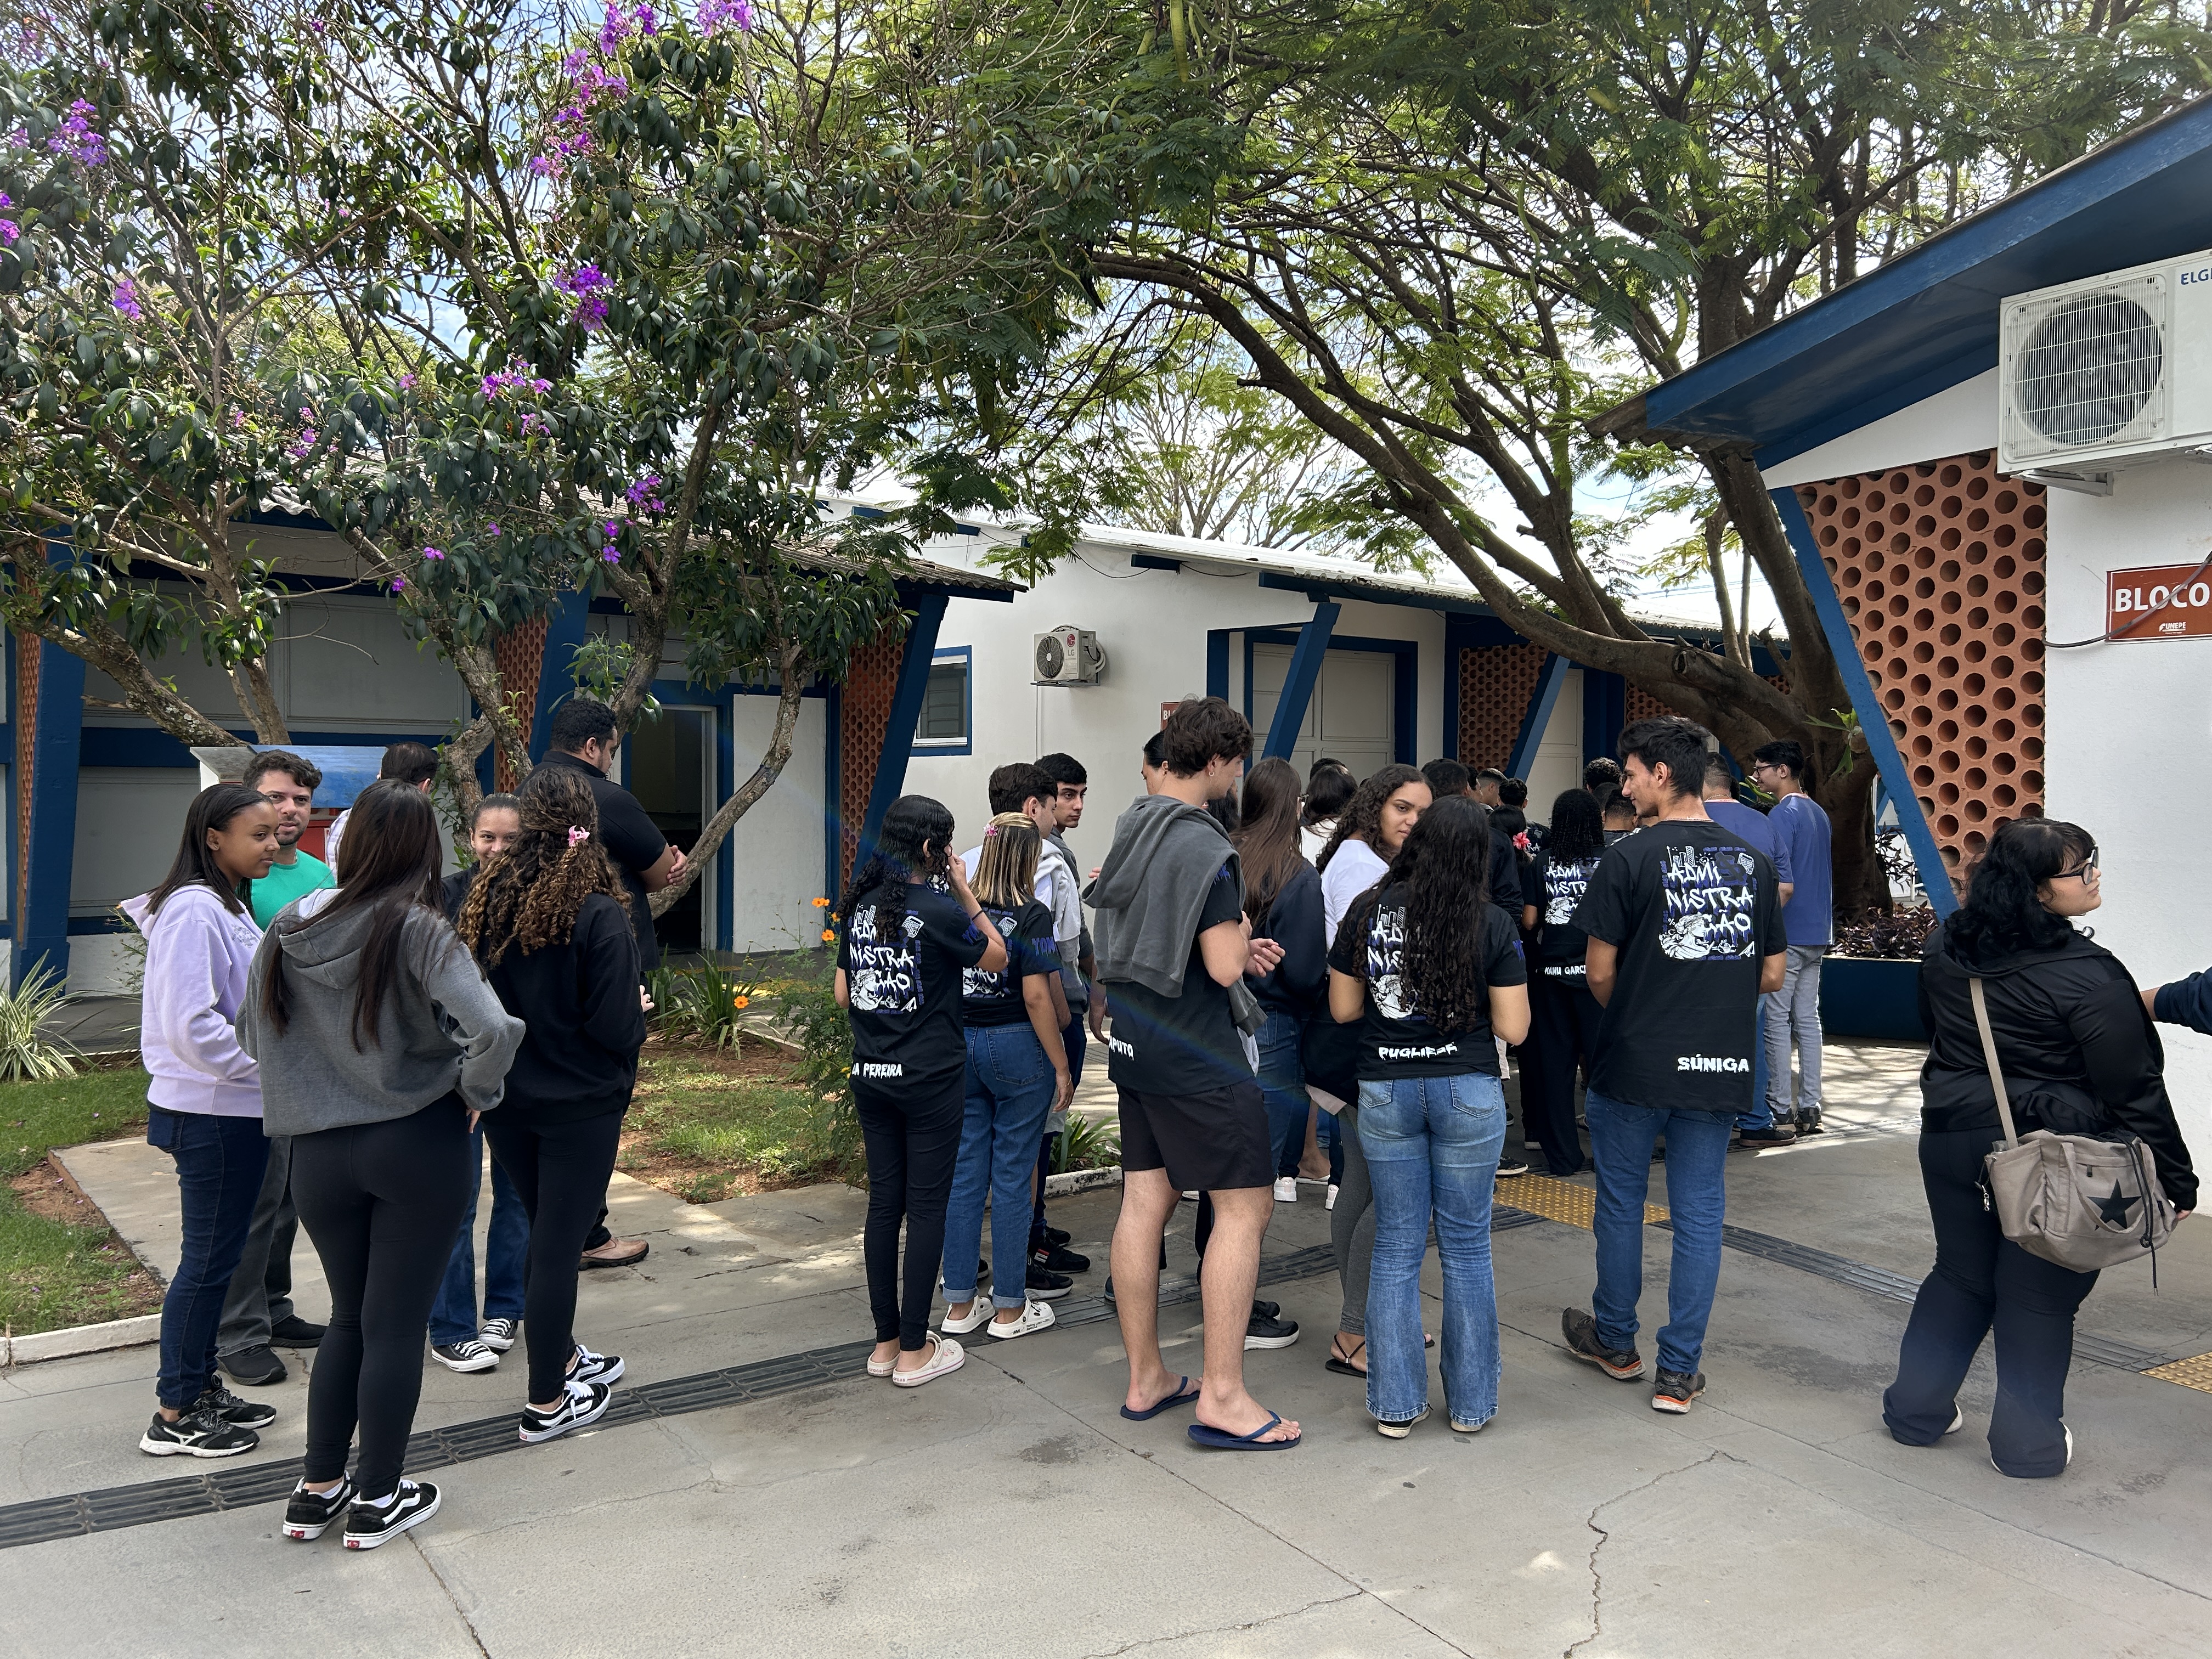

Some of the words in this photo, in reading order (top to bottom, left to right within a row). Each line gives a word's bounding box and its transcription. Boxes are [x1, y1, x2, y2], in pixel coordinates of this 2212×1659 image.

[2115, 582, 2210, 612] BLOCO
[2159, 622, 2186, 631] FUNEPE
[863, 1063, 903, 1079] PEREIRA
[1677, 1053, 1750, 1073] SÚNIGA
